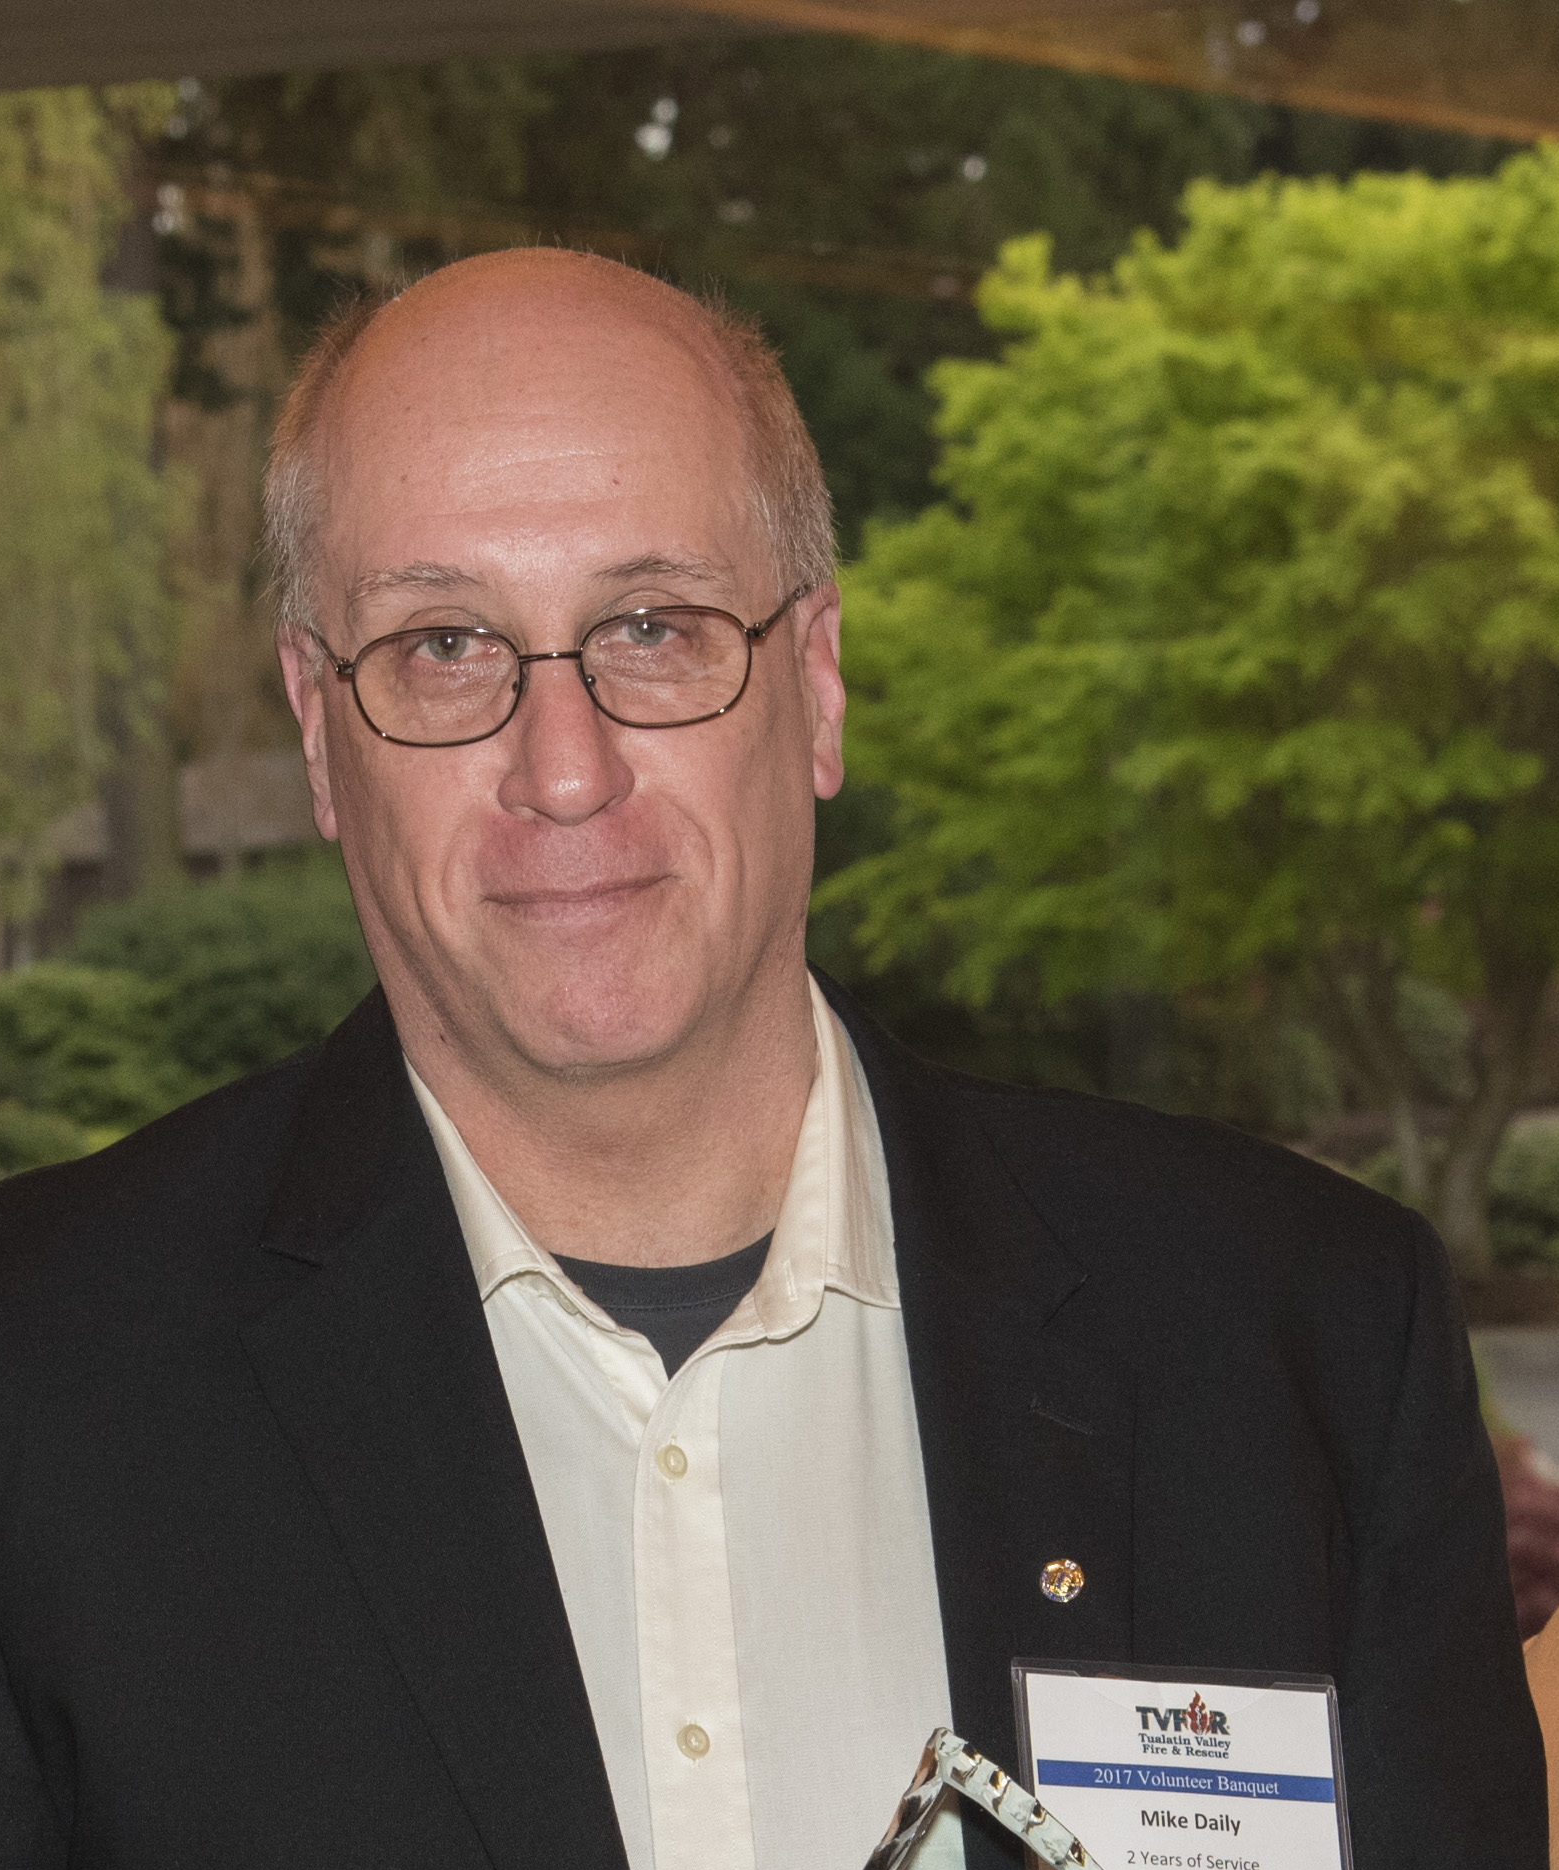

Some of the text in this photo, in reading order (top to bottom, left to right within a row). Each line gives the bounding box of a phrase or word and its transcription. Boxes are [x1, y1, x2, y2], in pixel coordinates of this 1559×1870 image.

[1138, 1732, 1232, 1751] Tualatin Valley
[1142, 1743, 1230, 1759] Fire & Rescue
[1093, 1767, 1280, 1797] 2017 Volunteer Banquet
[1140, 1810, 1242, 1836] Mike Daily
[1126, 1850, 1137, 1865] 2
[1140, 1851, 1183, 1868] Years
[1187, 1853, 1204, 1869] of
